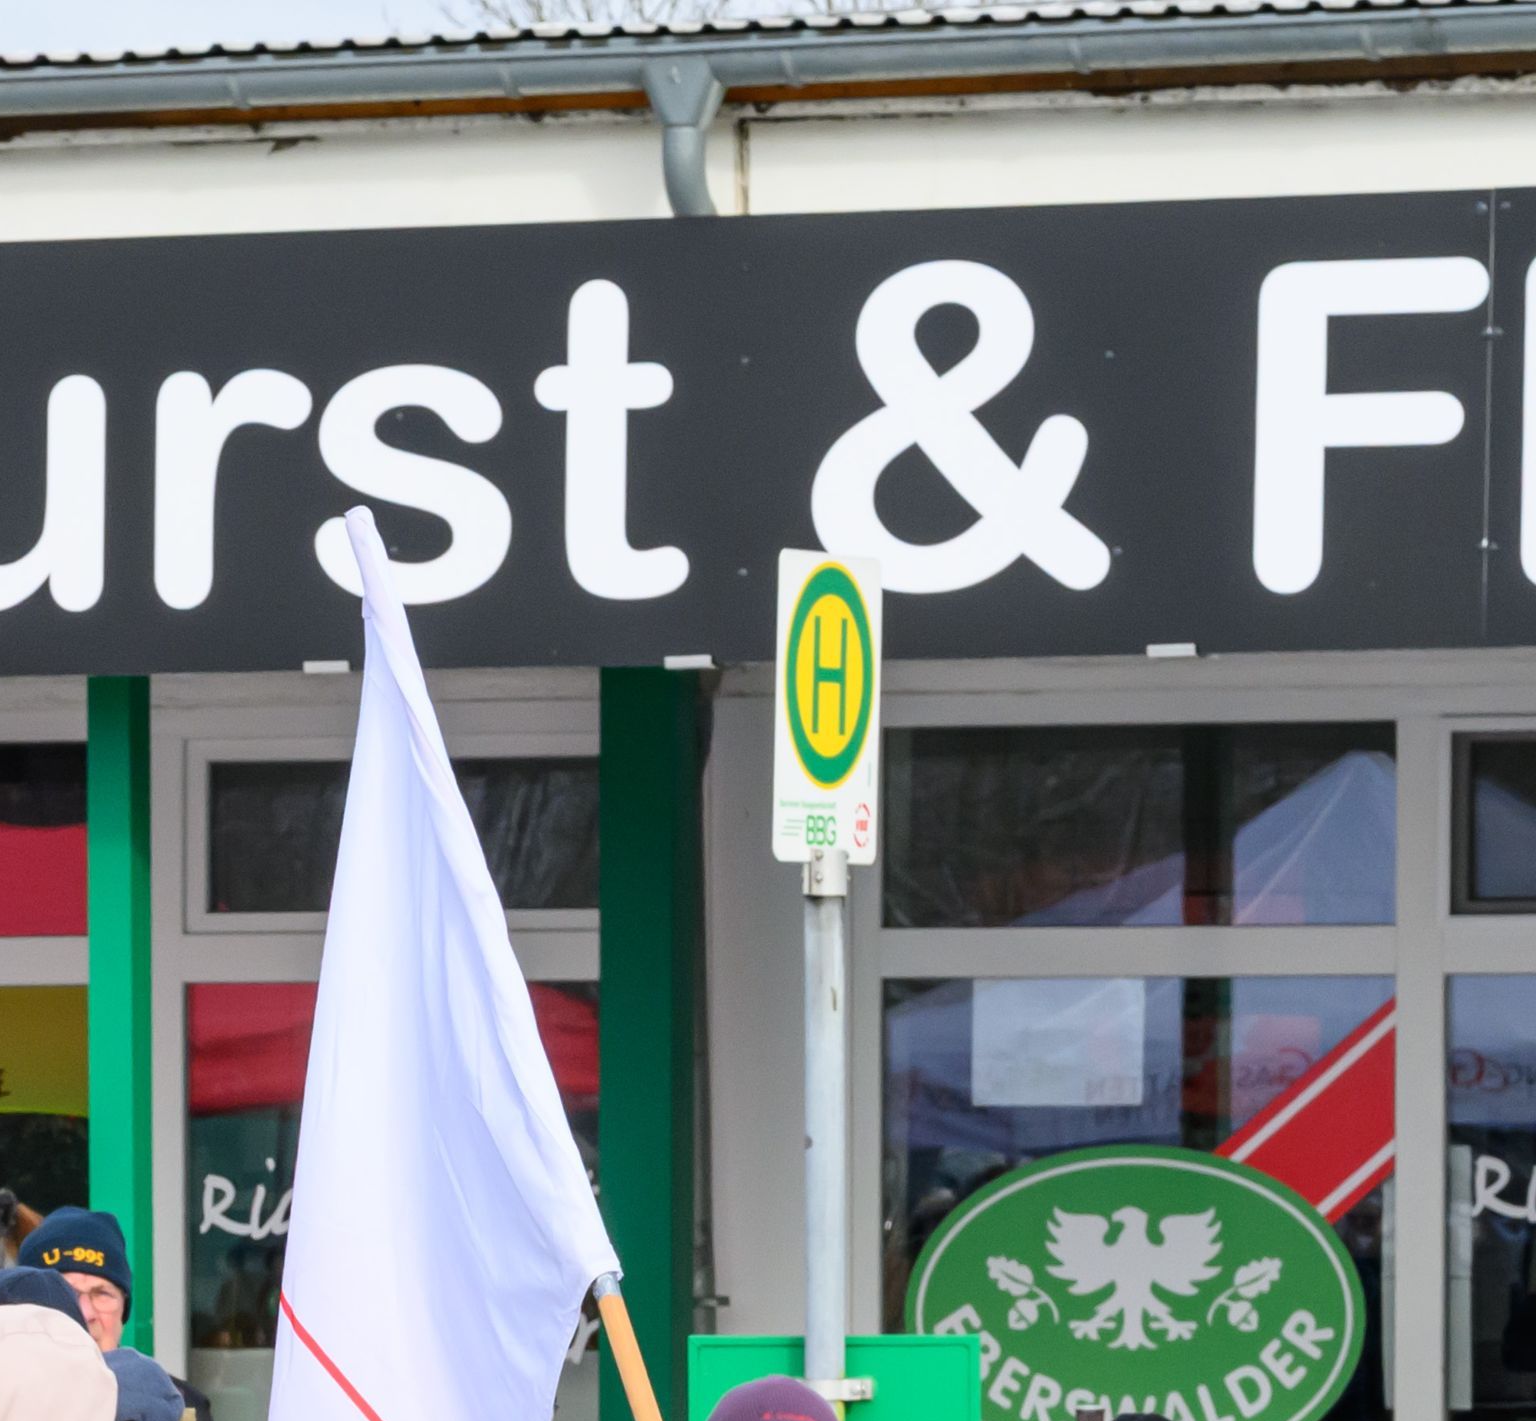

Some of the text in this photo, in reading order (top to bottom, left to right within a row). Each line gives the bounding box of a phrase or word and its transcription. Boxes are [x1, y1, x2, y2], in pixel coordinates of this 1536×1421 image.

[774, 260, 1111, 595] &
[812, 615, 848, 737] H
[42, 1246, 105, 1268] U-995
